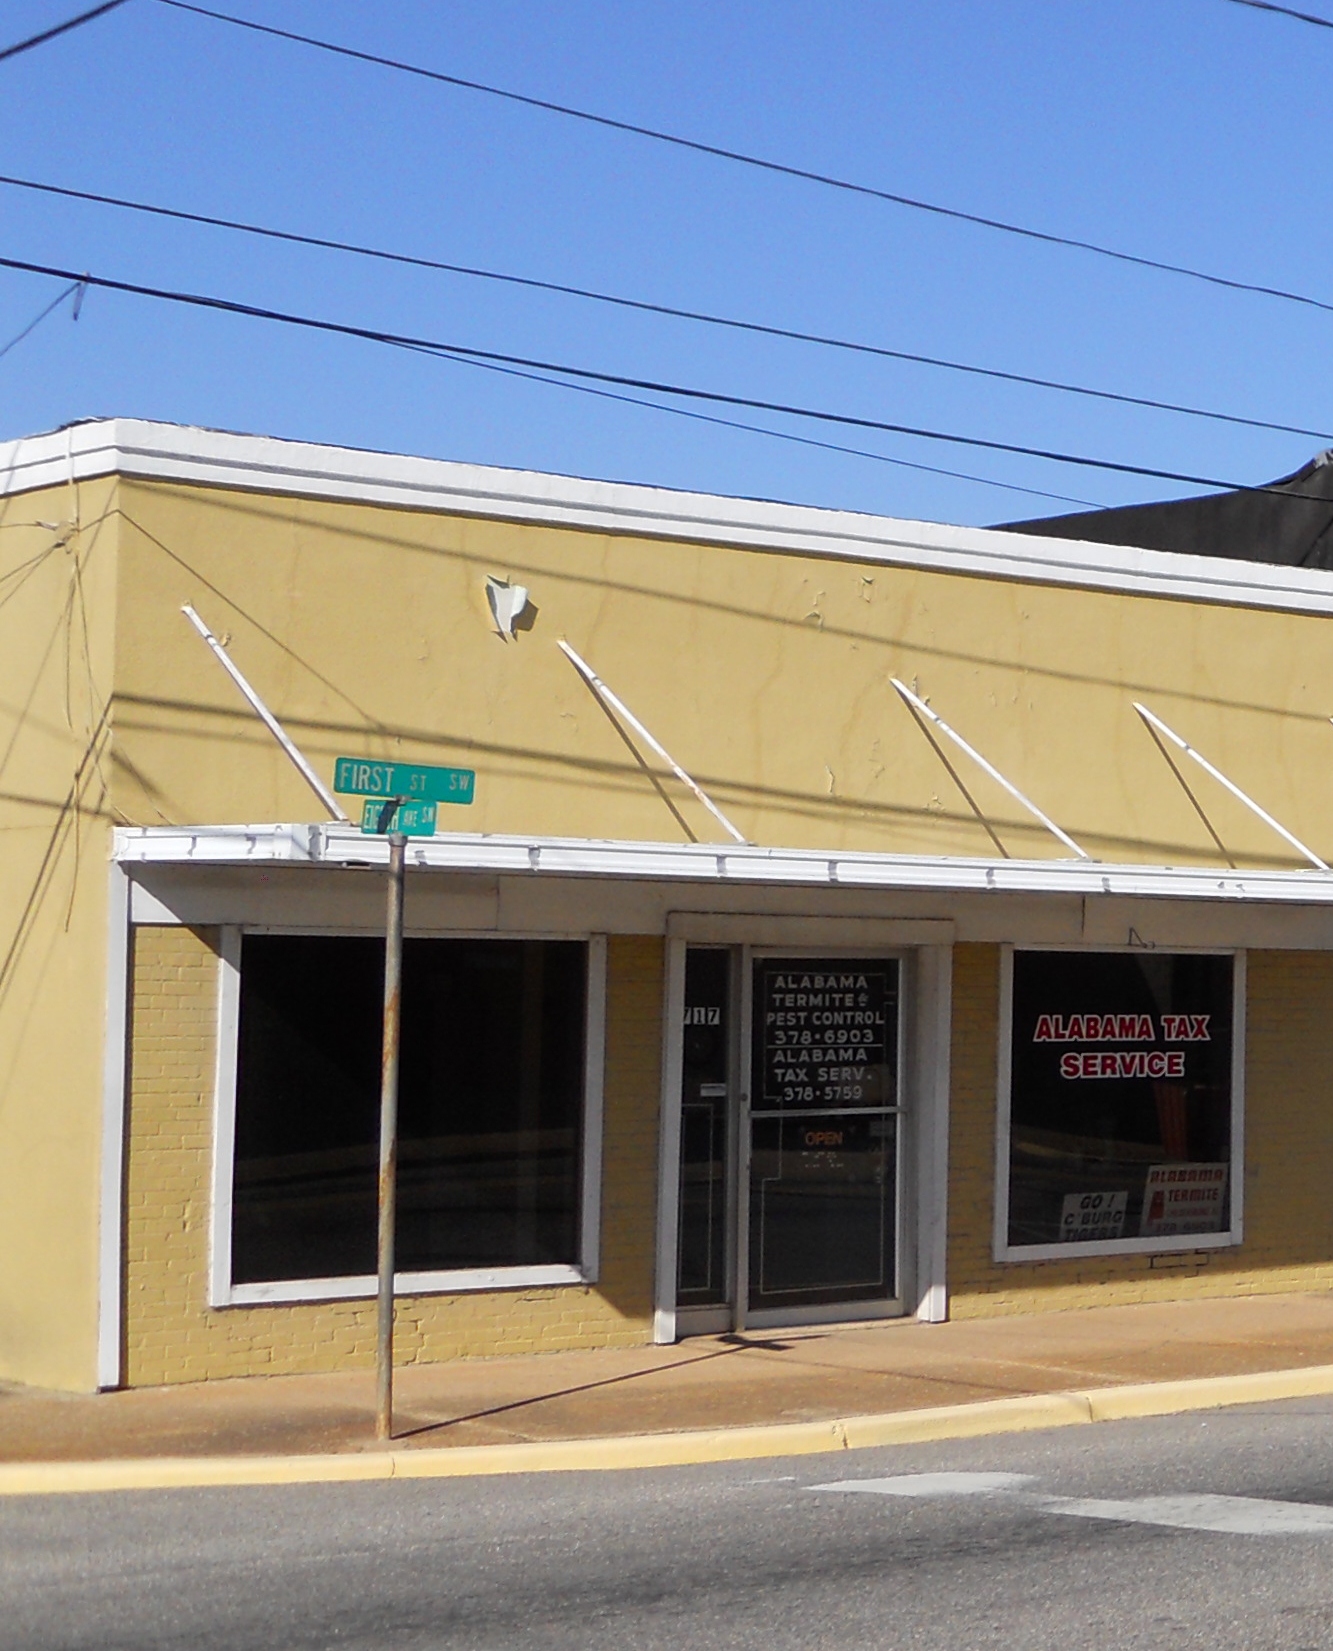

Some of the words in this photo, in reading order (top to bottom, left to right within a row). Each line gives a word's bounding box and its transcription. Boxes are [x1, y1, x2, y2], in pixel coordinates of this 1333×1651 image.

[340, 763, 394, 791] FIRST
[409, 773, 427, 790] ST
[449, 773, 471, 791] SW
[363, 804, 400, 830] EIGH
[403, 810, 418, 827] AVE
[422, 806, 435, 823] SW
[774, 974, 868, 990] ALABAMA
[772, 993, 854, 1007] TERMITE
[766, 1012, 808, 1026] PEST
[812, 1010, 885, 1026] CONTROL
[1033, 1014, 1155, 1042] ALABAMA
[1162, 1014, 1211, 1042] TAX
[772, 1048, 868, 1063] ALABAMA
[1060, 1052, 1185, 1079] SERVICE
[774, 1068, 809, 1083] TAX
[805, 1131, 844, 1147] OPEN
[1150, 1169, 1225, 1183] ALABAMA
[1080, 1195, 1103, 1210] GO
[1168, 1188, 1220, 1203] TERMITE
